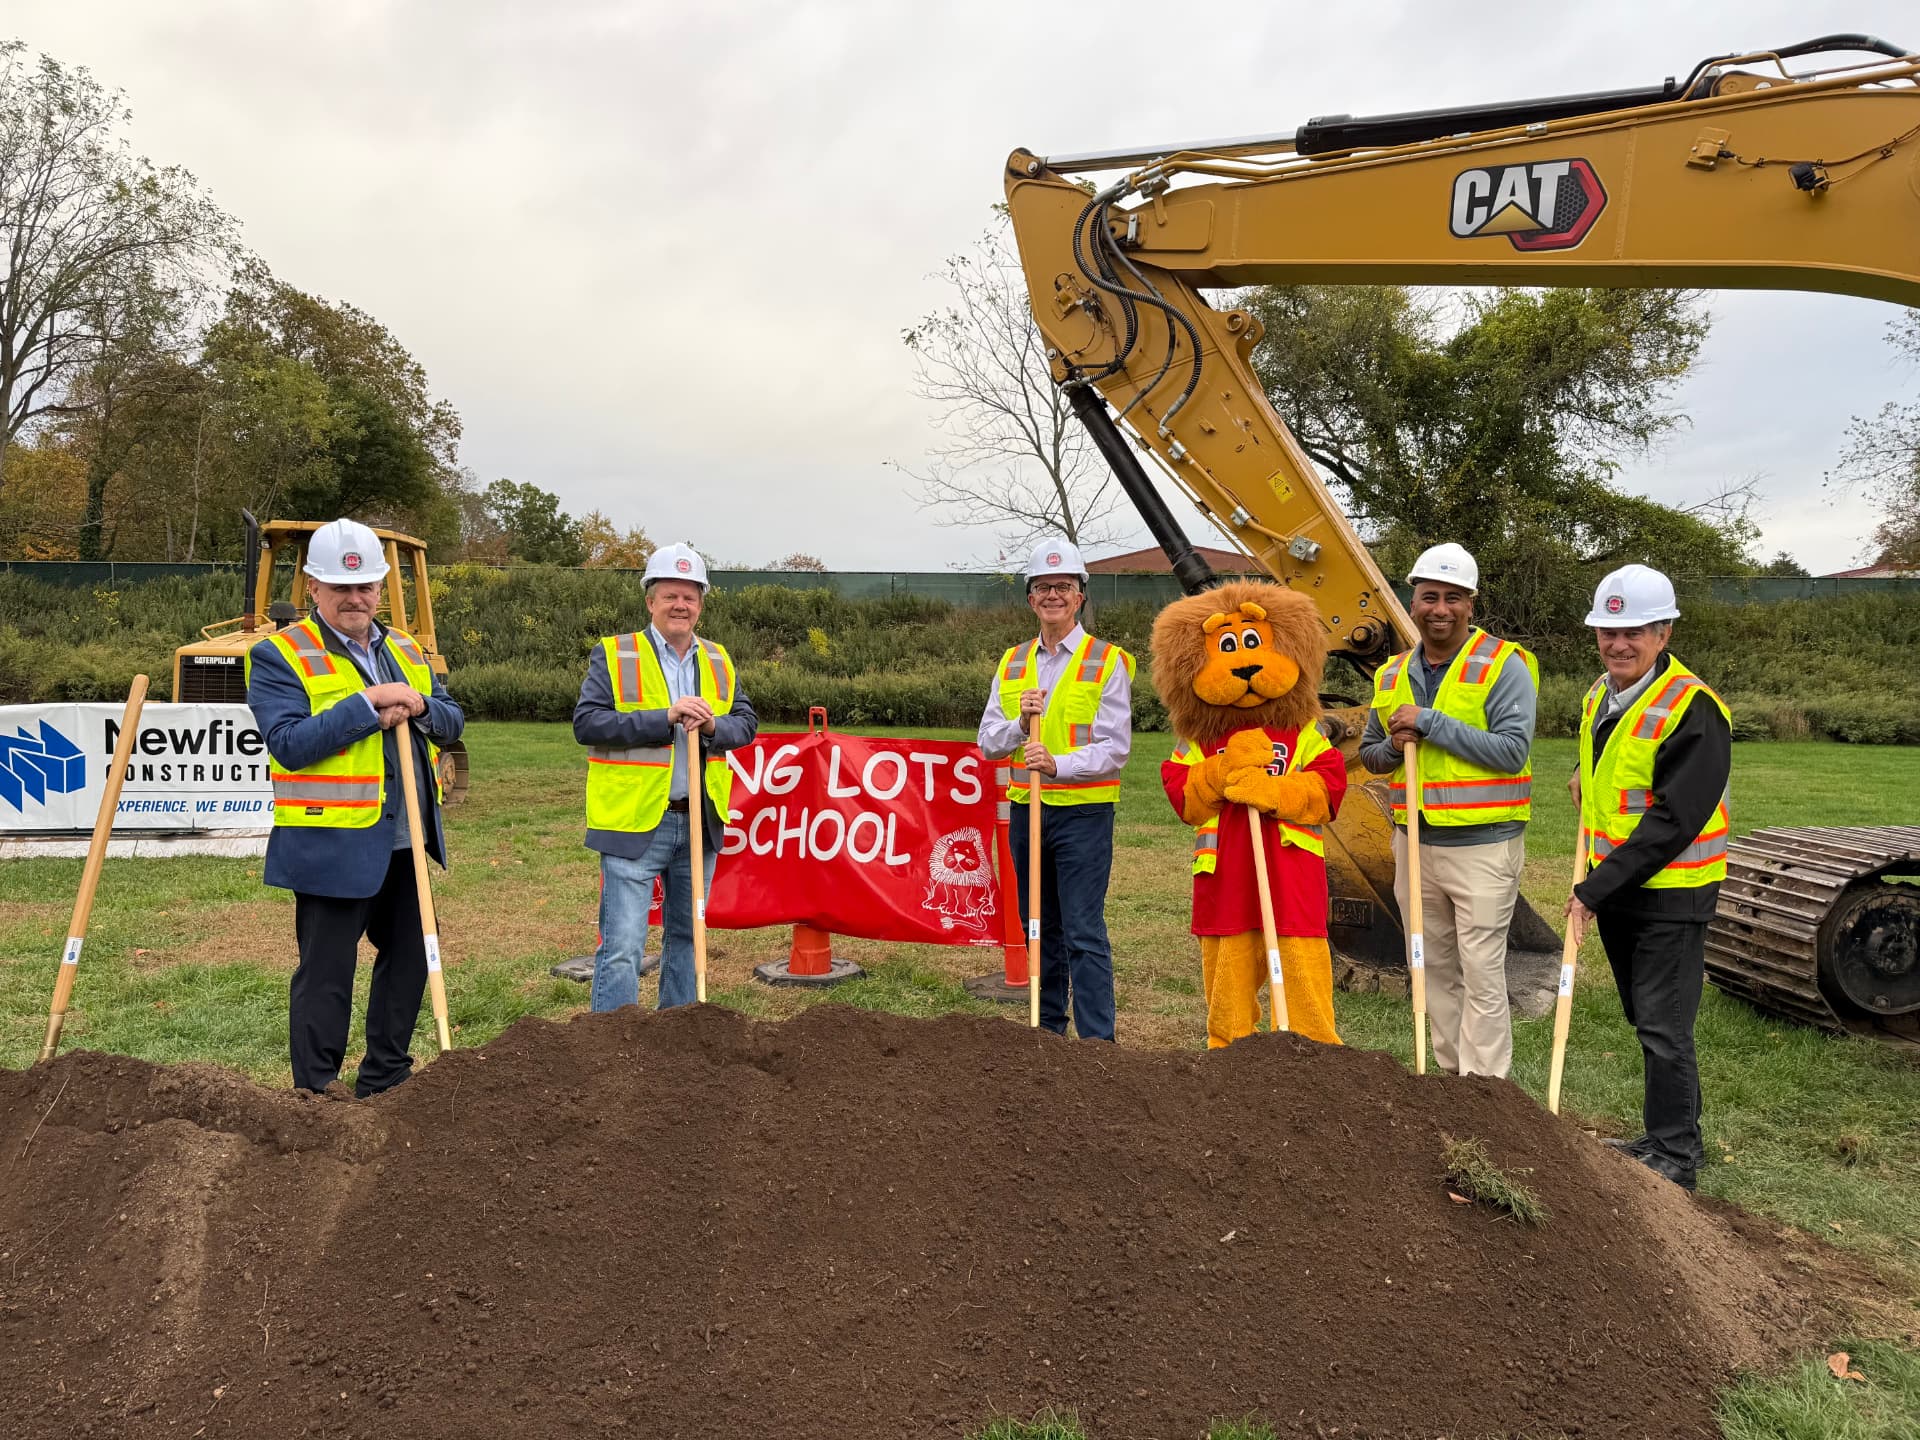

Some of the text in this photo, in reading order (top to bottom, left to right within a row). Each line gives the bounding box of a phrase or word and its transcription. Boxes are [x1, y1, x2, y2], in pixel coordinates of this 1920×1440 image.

[1452, 161, 1570, 236] CAT
[194, 656, 236, 665] CATERPILLAR
[827, 745, 982, 804] LOTS
[116, 800, 189, 813] XPERIENCE.
[196, 800, 218, 813] WE
[223, 800, 263, 813] BUILD
[718, 805, 912, 866] SCHOOL
